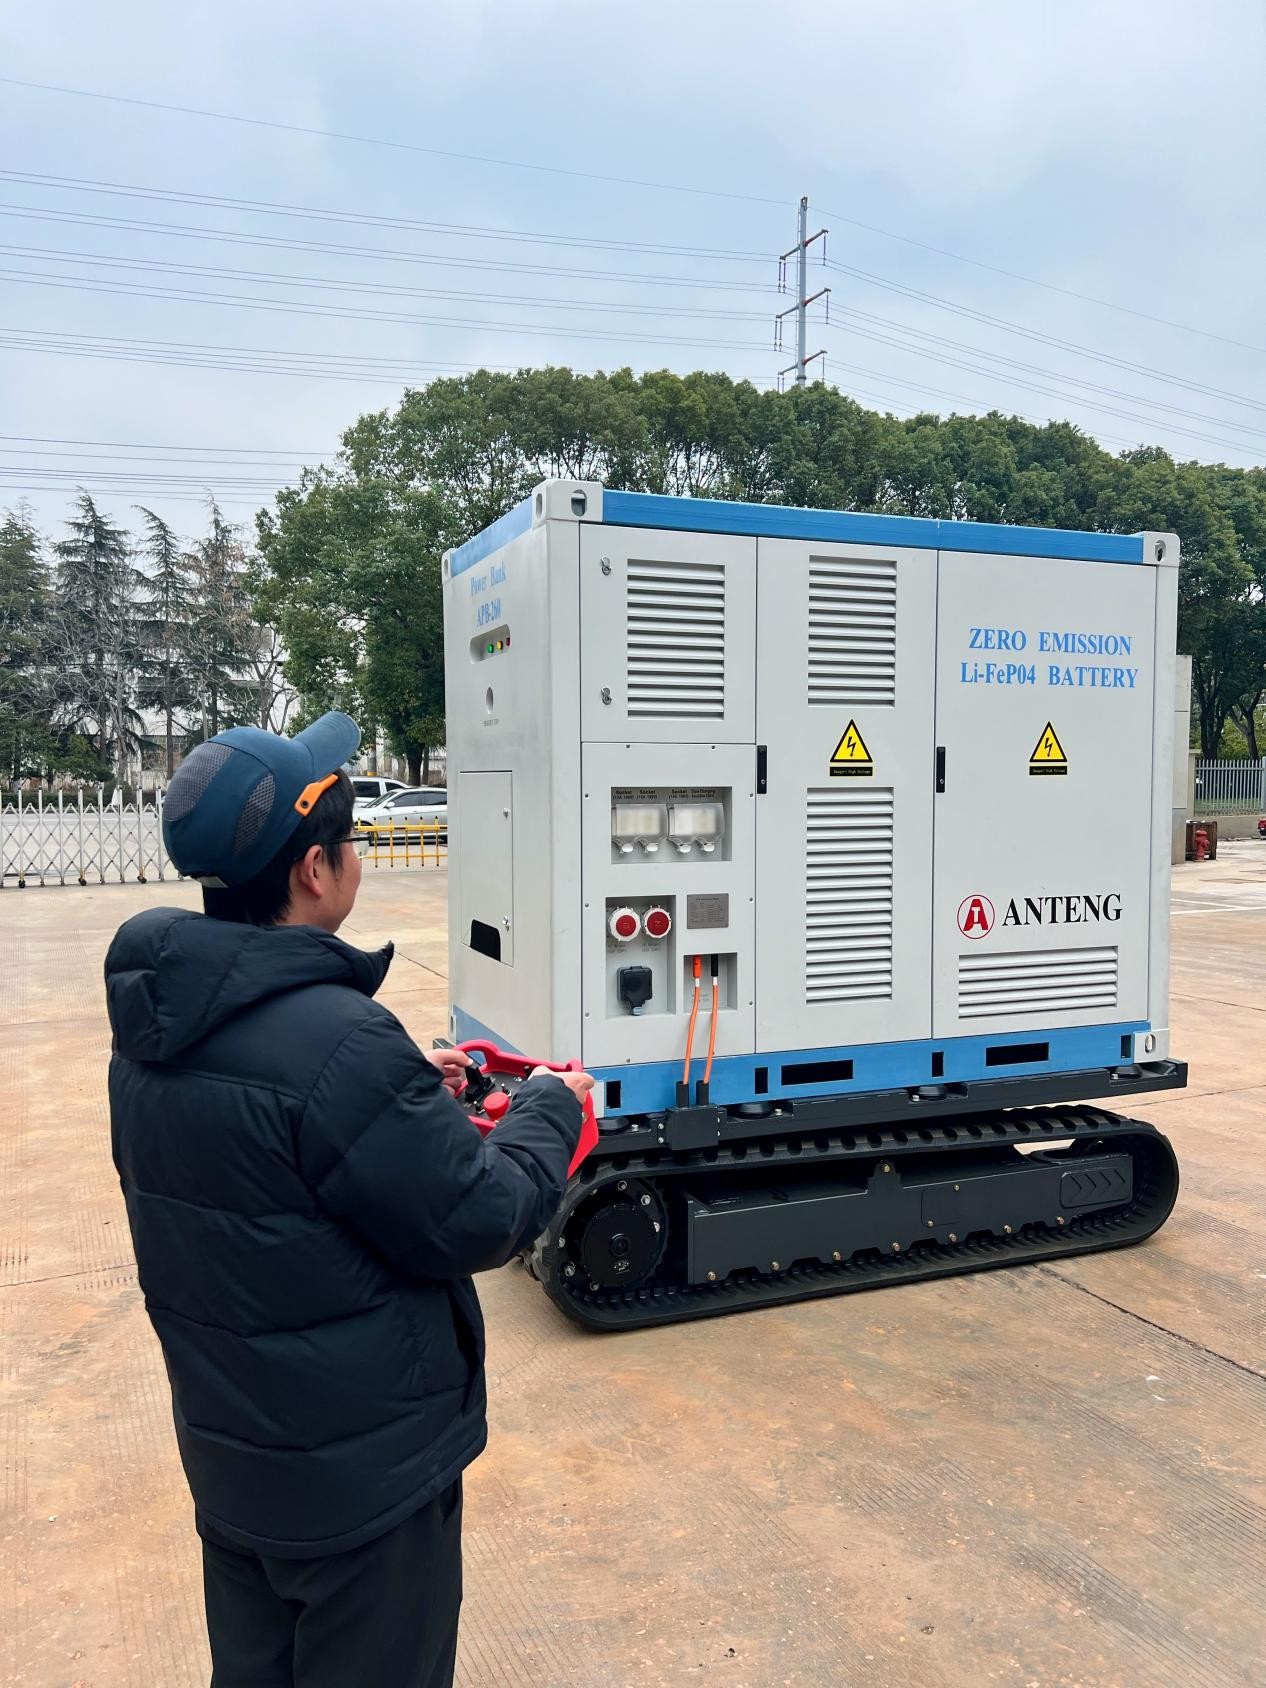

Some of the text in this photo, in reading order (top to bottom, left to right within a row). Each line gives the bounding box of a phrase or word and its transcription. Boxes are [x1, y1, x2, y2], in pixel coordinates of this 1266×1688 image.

[968, 628, 1133, 656] ZERO EMISSION
[1047, 665, 1139, 688] BATTERY
[1002, 893, 1123, 927] ANTENG
